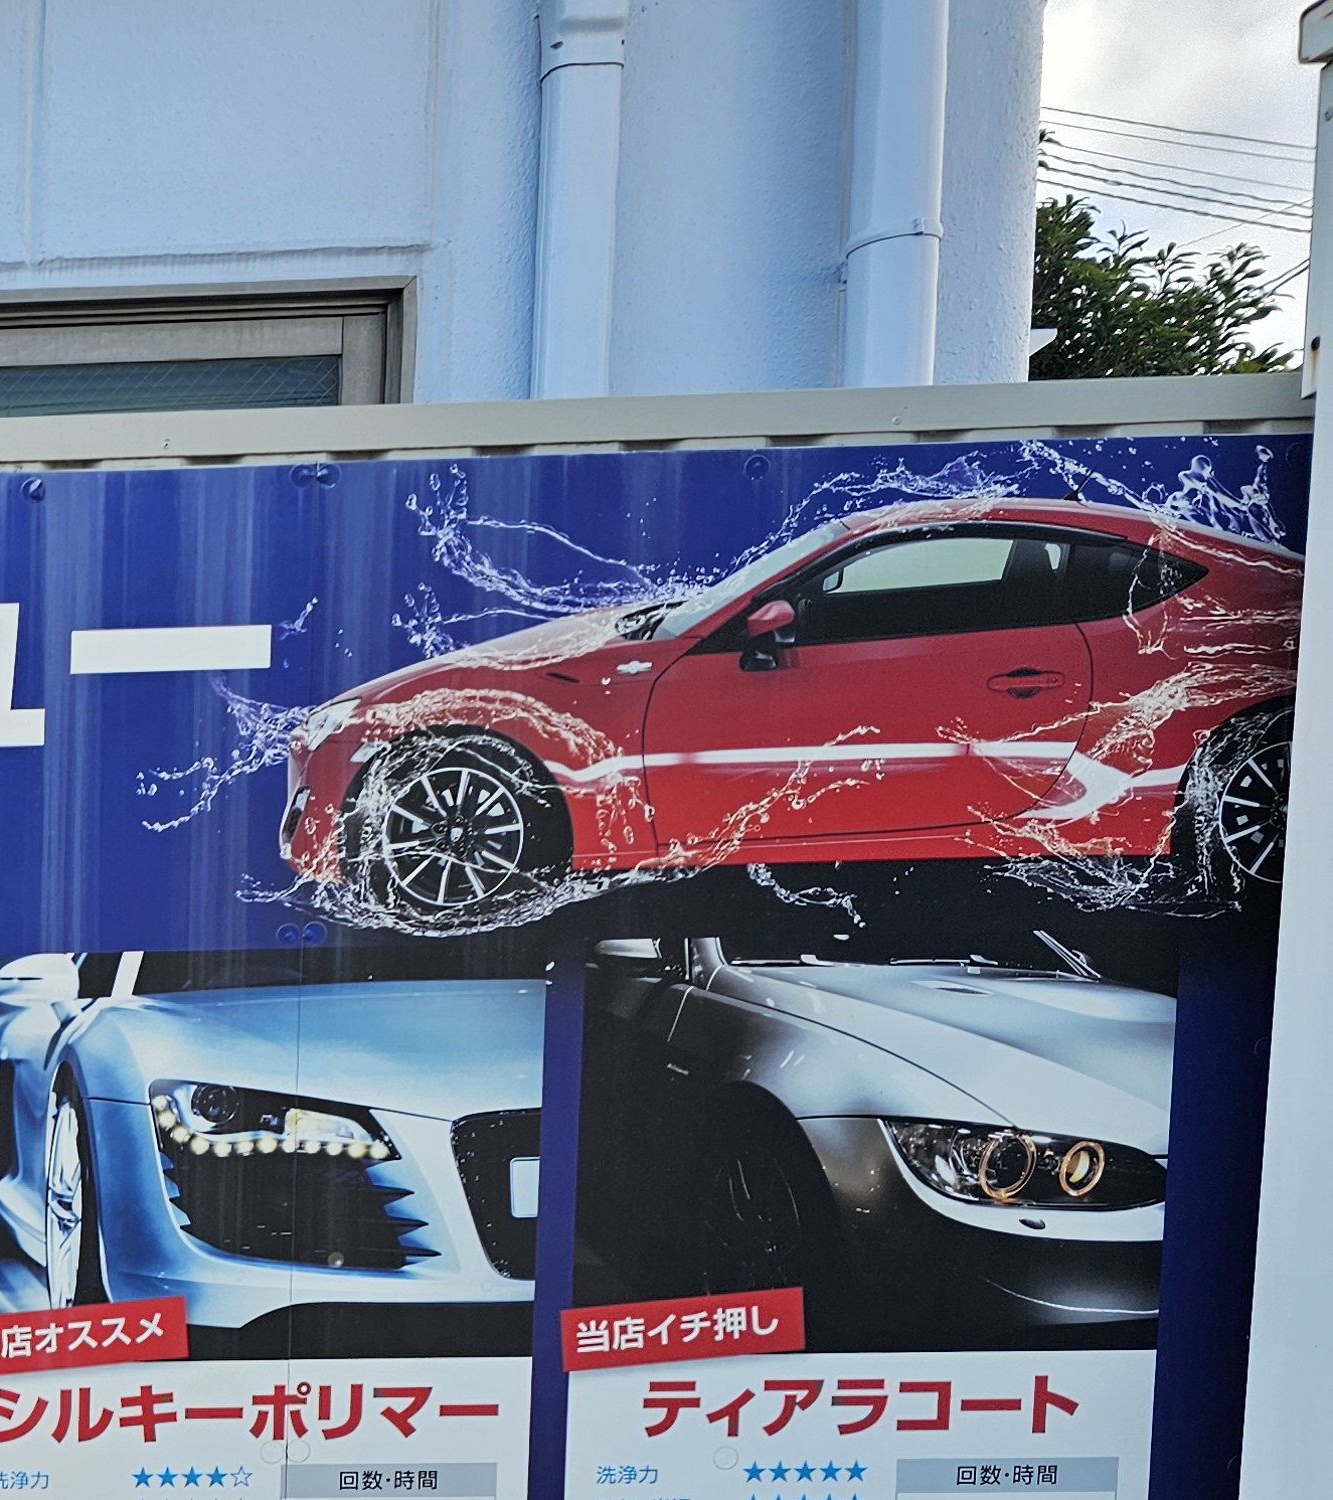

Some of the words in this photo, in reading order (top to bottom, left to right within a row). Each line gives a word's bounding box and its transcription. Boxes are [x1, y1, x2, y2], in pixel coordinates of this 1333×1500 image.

[575, 1305, 780, 1354] 当店イチ押し
[642, 1374, 1080, 1438] ティアラコート
[596, 1465, 659, 1485] 洗浄力
